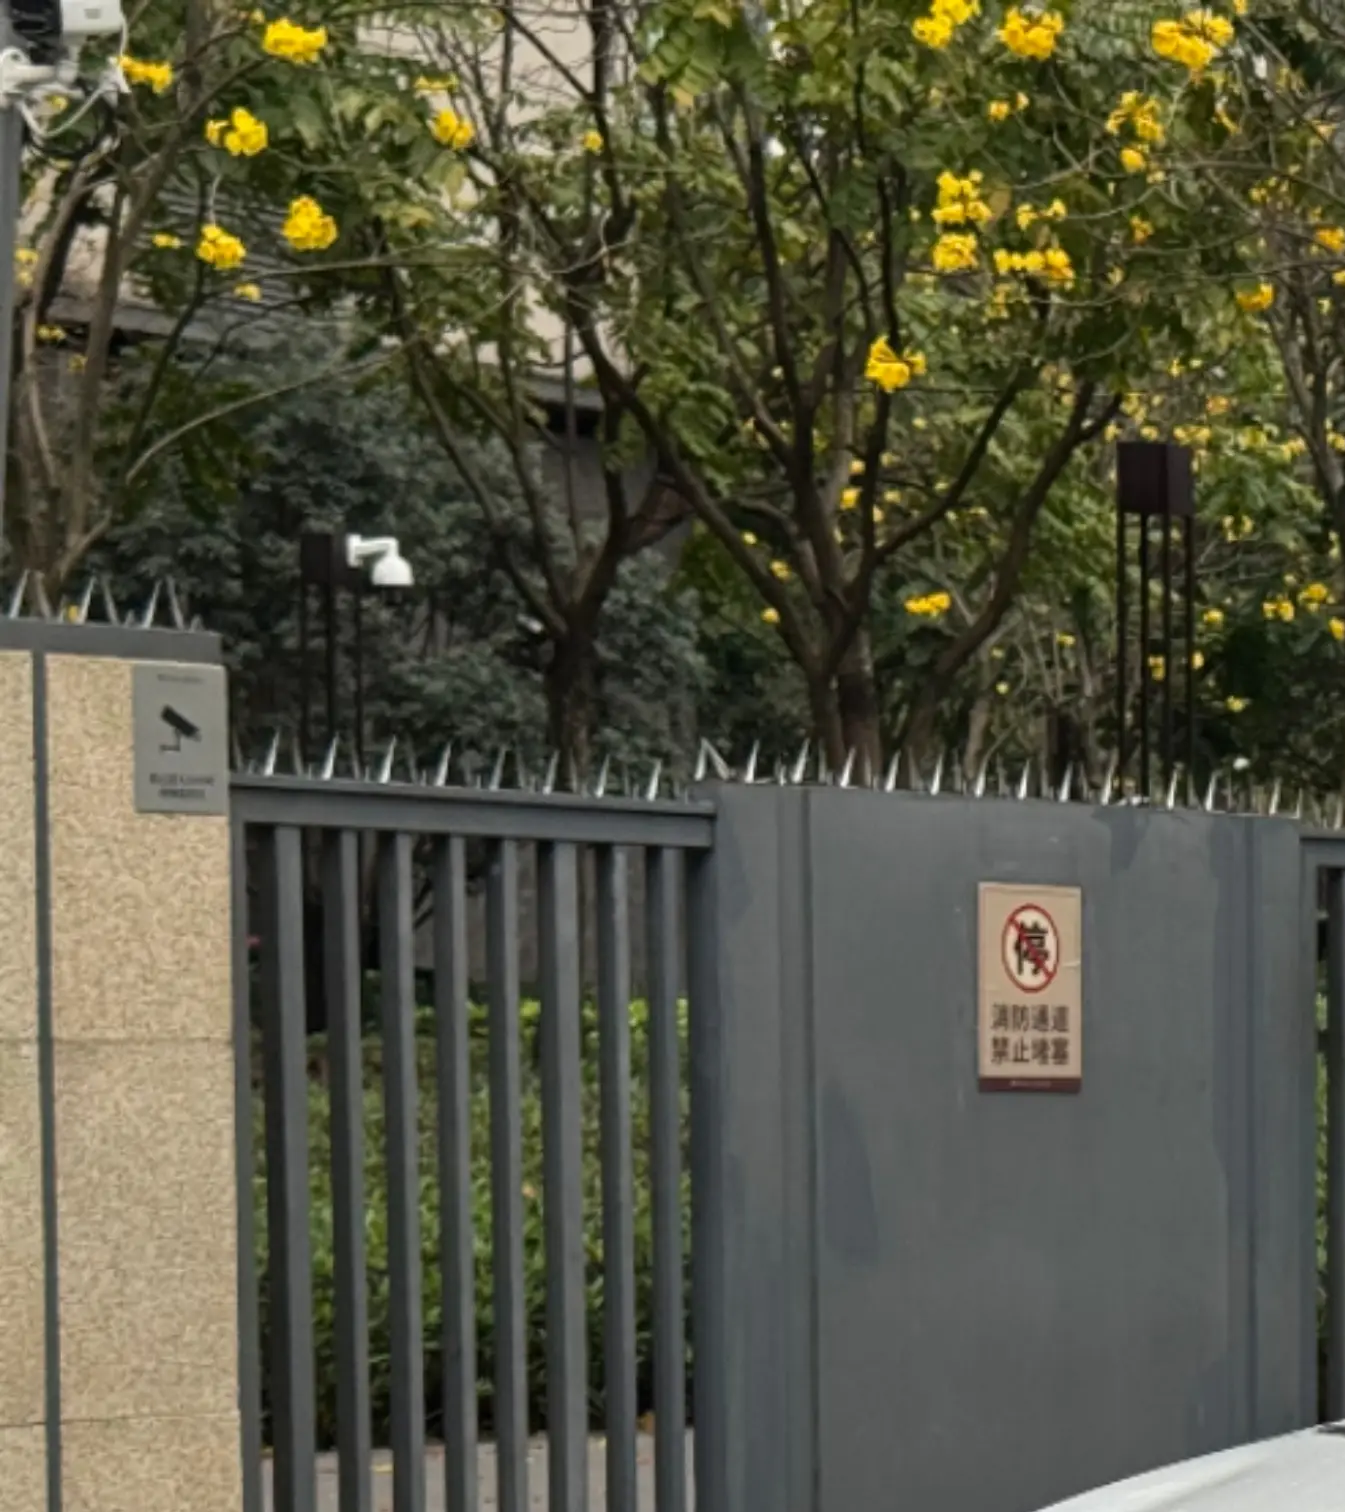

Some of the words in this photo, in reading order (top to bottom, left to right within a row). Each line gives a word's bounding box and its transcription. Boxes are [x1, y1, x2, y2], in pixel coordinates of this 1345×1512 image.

[1014, 920, 1050, 975] 停
[990, 1003, 1069, 1032] 消防通道
[990, 1035, 1069, 1066] 禁止堵塞
